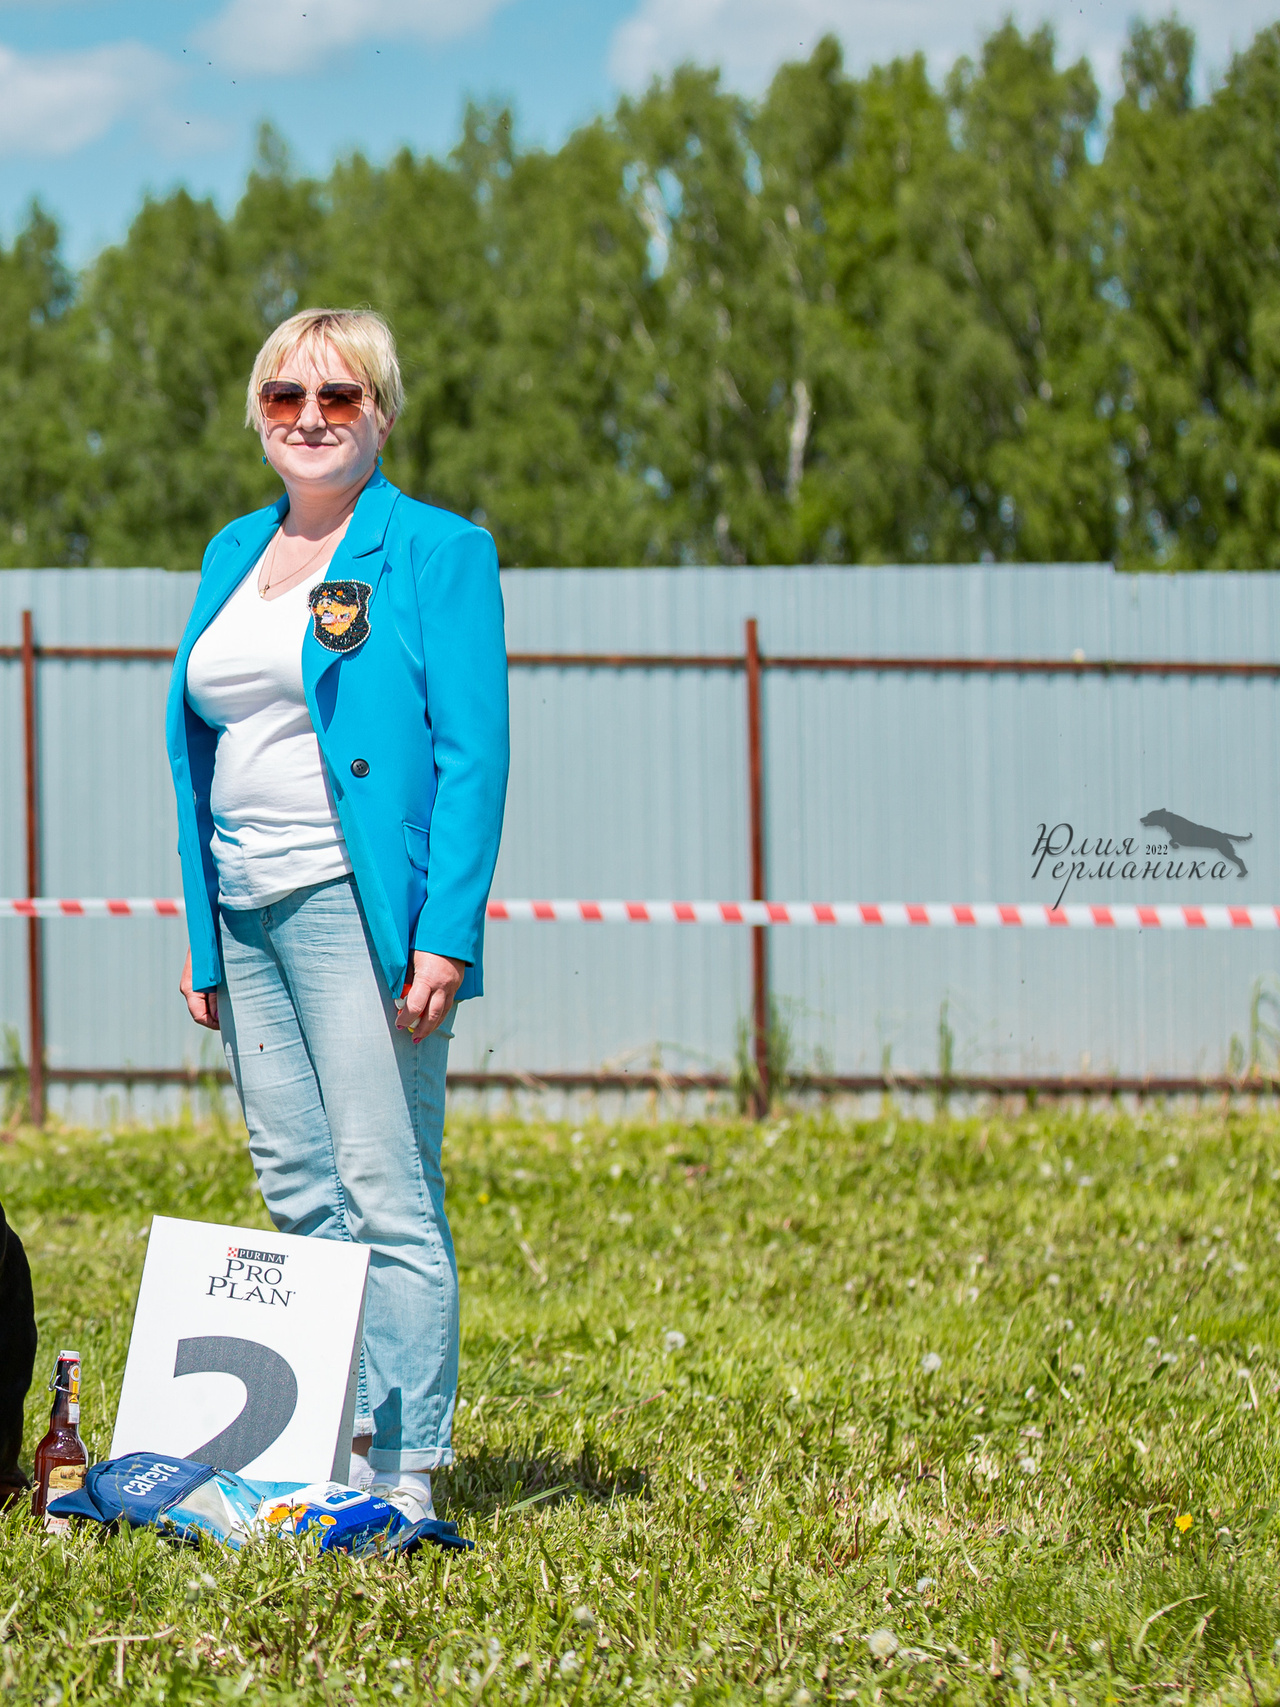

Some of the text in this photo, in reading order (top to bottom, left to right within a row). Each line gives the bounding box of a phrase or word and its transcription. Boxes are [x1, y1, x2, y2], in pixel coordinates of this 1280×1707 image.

[238, 1248, 284, 1264] PURINA
[223, 1258, 282, 1285] PRO
[205, 1275, 293, 1307] PLAN
[173, 1335, 298, 1473] 2
